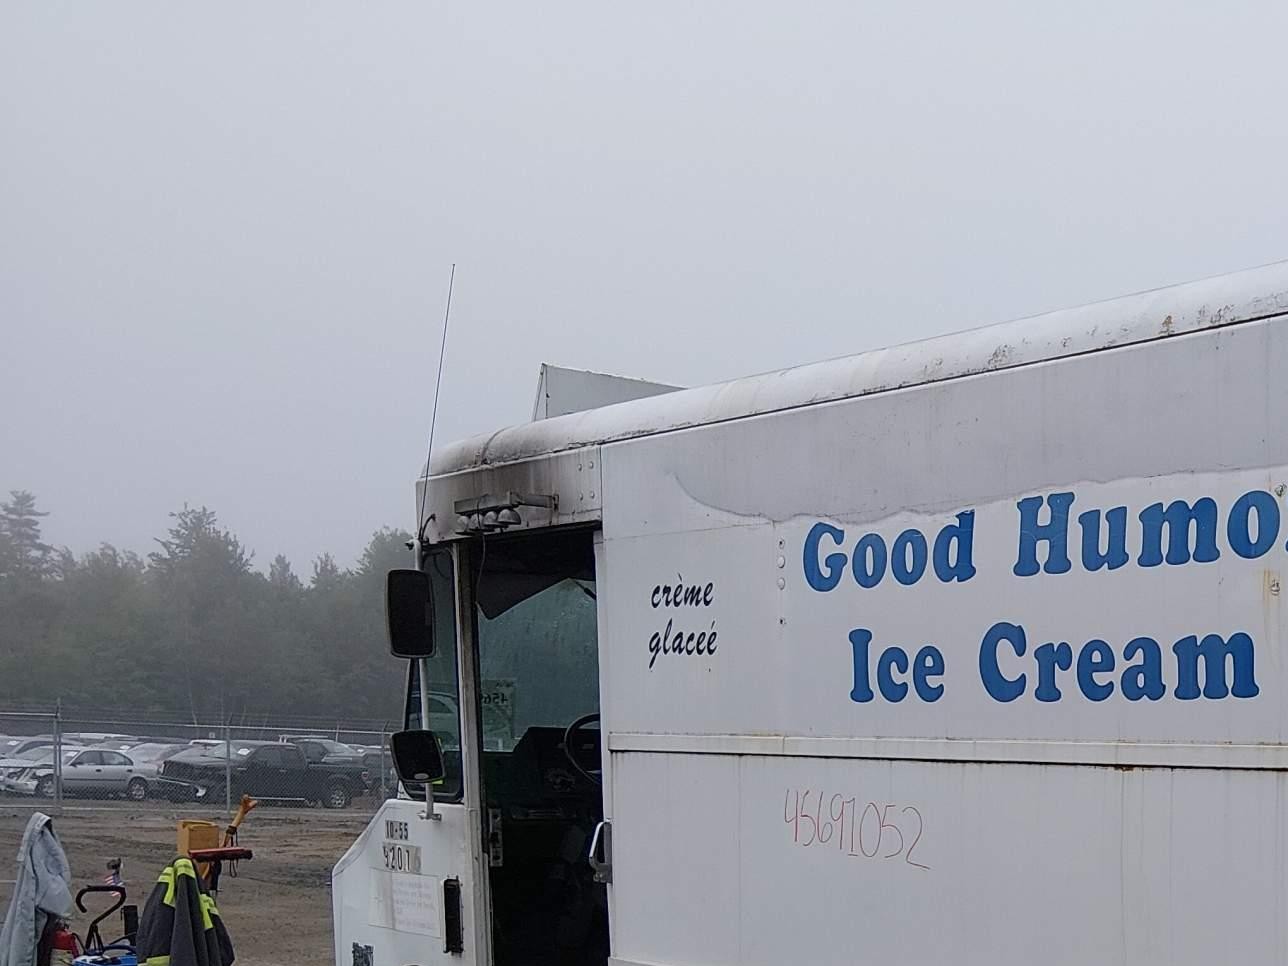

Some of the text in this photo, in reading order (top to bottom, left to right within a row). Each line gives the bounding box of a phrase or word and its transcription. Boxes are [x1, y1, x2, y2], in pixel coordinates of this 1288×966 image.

[651, 572, 714, 609] crème
[803, 510, 977, 593] Good
[848, 622, 1261, 704] Ice Cream
[784, 788, 932, 871] 45691052
